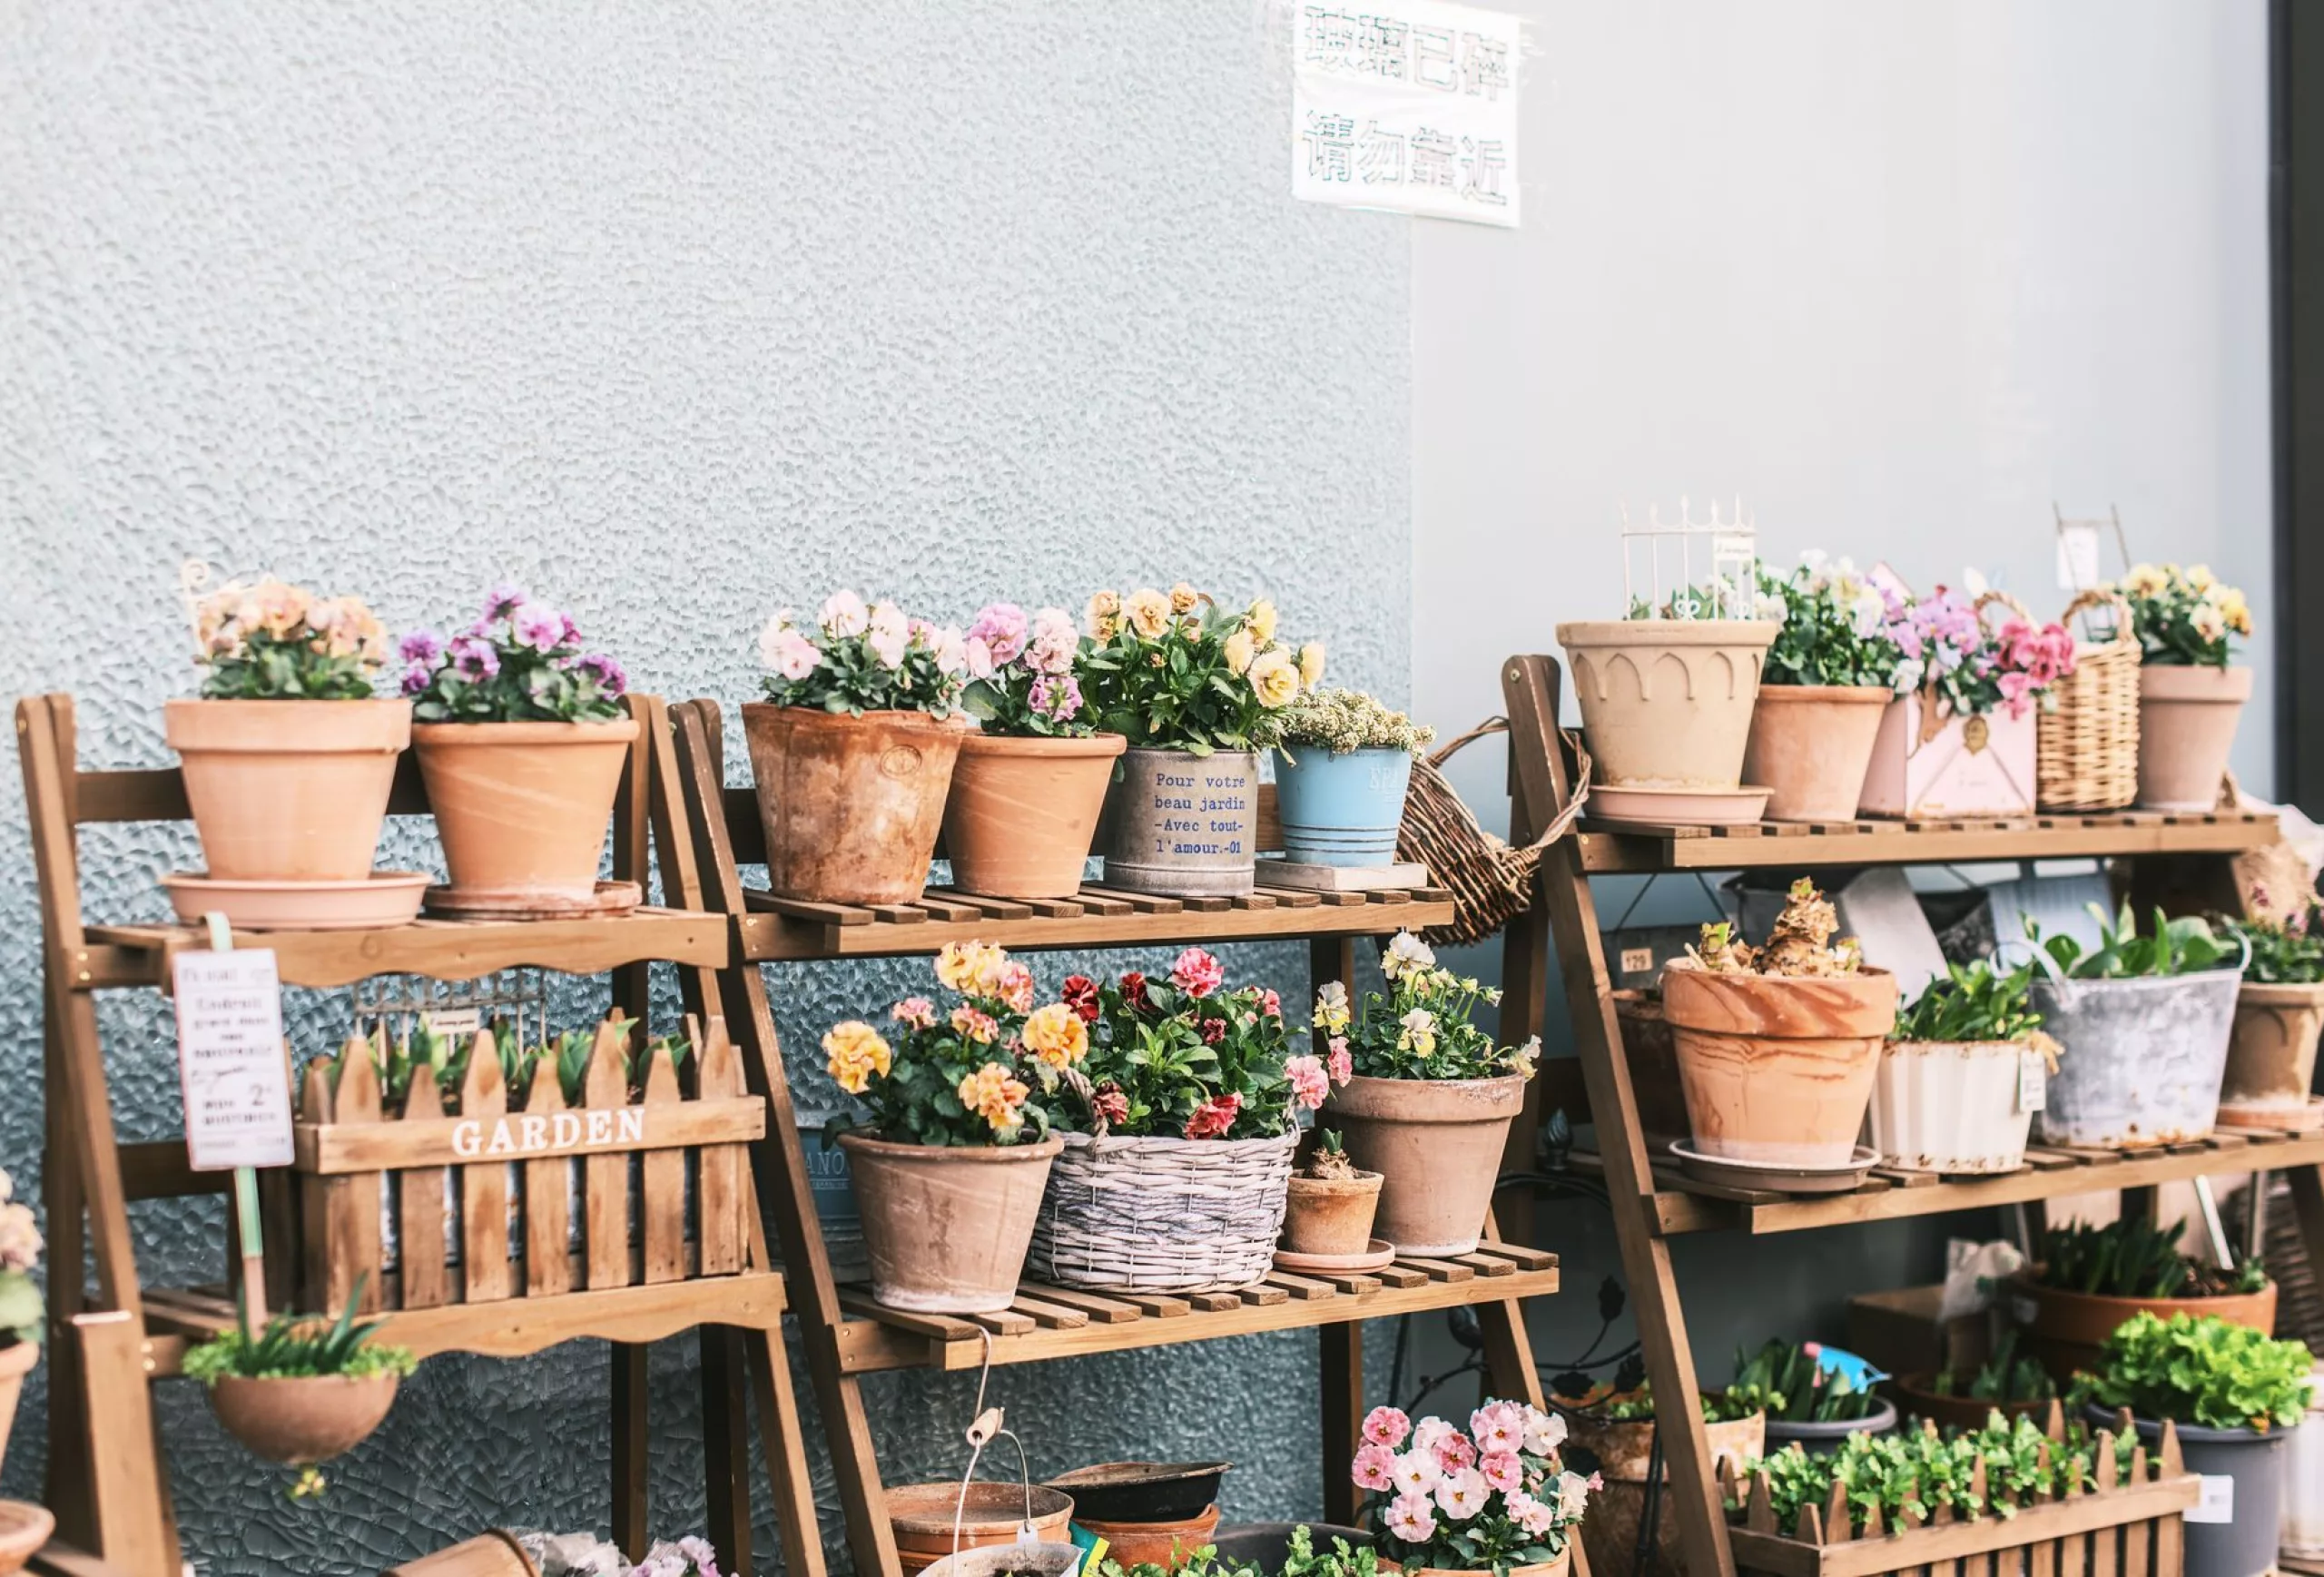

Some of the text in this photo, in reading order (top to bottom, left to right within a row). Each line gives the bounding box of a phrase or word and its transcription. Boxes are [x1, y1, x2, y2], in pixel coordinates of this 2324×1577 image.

[1302, 109, 1508, 206] 请勿靠近
[1156, 773, 1246, 788] Pour votre
[1155, 795, 1245, 813] beau jardin
[453, 1109, 645, 1157] GARDEN
